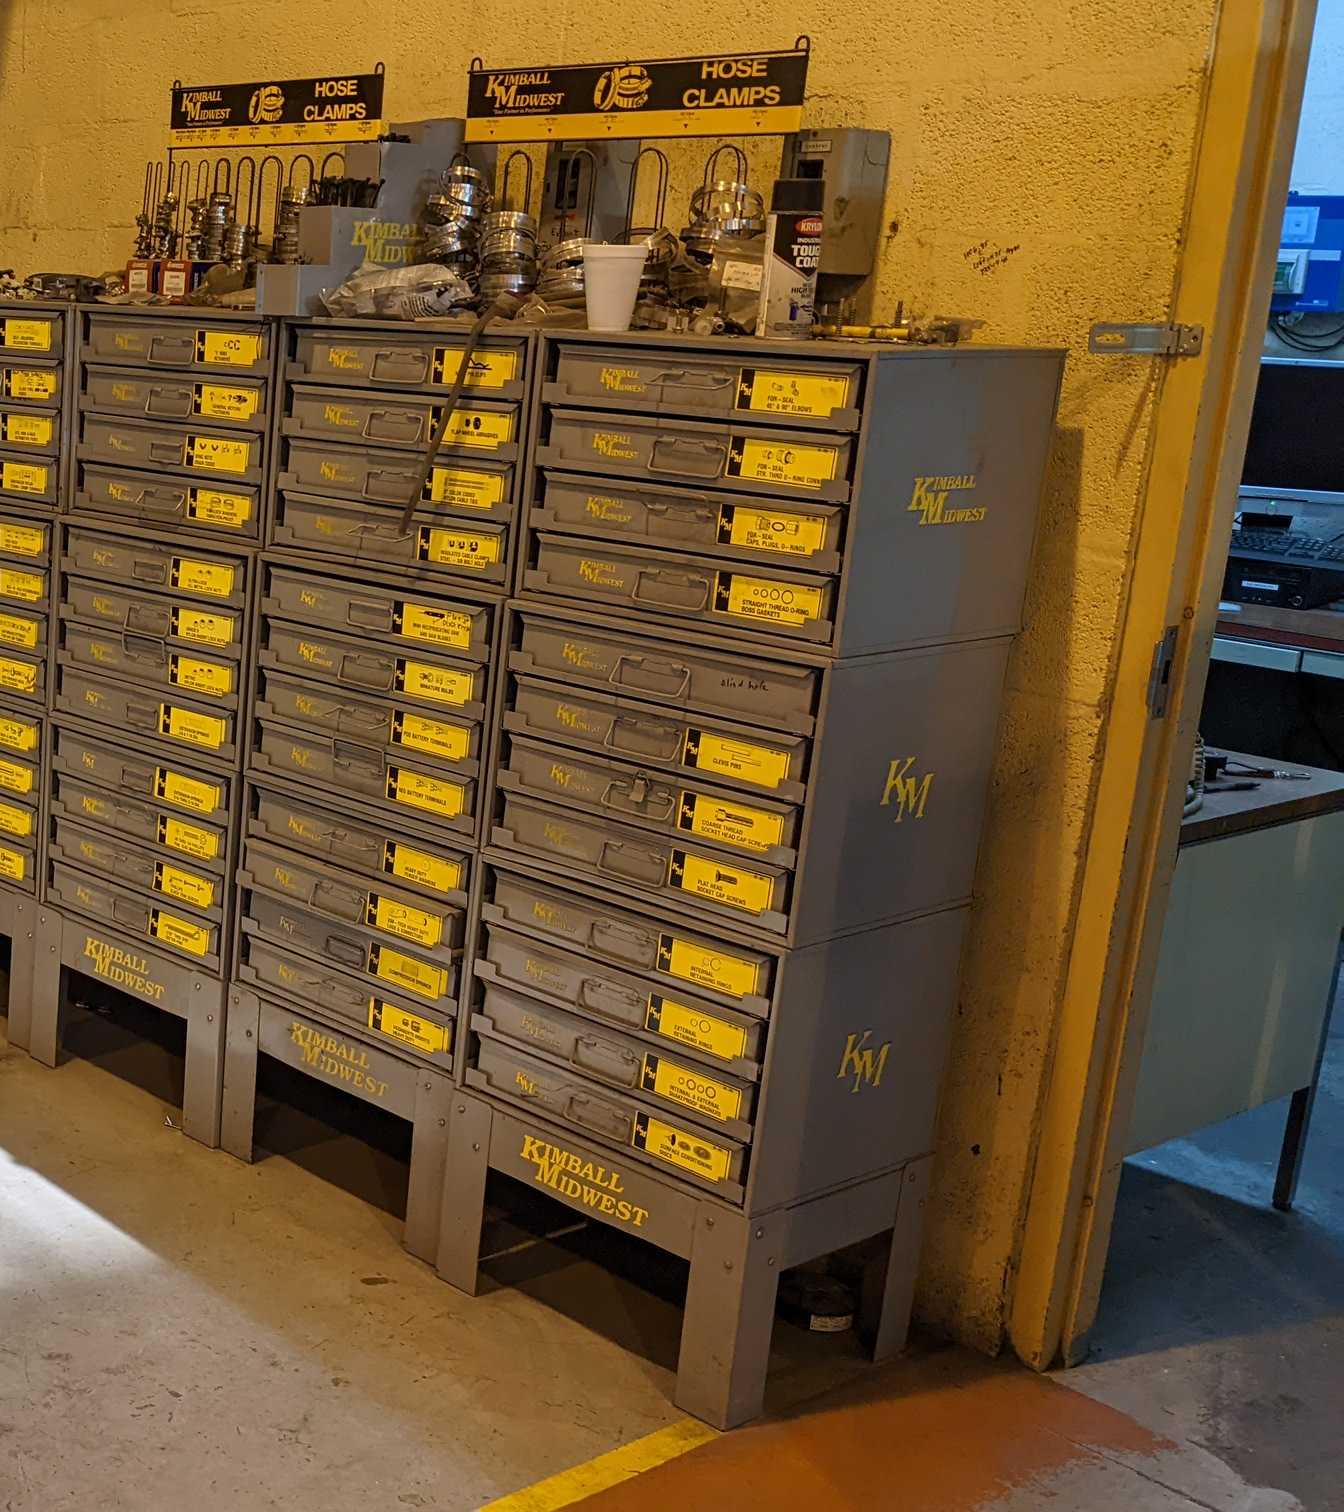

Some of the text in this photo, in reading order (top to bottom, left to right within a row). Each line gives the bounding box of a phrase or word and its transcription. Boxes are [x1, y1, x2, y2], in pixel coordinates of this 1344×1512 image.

[485, 72, 551, 97] KIMBALL
[701, 59, 768, 79] HOSE
[181, 91, 222, 112] KIMBALL
[314, 79, 358, 98] HOSE
[494, 85, 564, 108] MIDWEST
[682, 85, 781, 108] CLAMPS
[187, 102, 232, 121] MIDWEST
[303, 102, 366, 121] CLAMPS
[908, 475, 976, 511] KIMBALL
[919, 491, 987, 525] MIDWEST
[880, 756, 936, 823] KM
[83, 936, 150, 975] KIMBALL
[93, 957, 165, 1000] MIDWEST
[287, 1022, 370, 1068] KIMBALL
[836, 1030, 892, 1093] KM
[300, 1044, 389, 1097] MIDWEST
[519, 1135, 624, 1193] KIMBALL
[534, 1161, 649, 1228] MIDWEST
